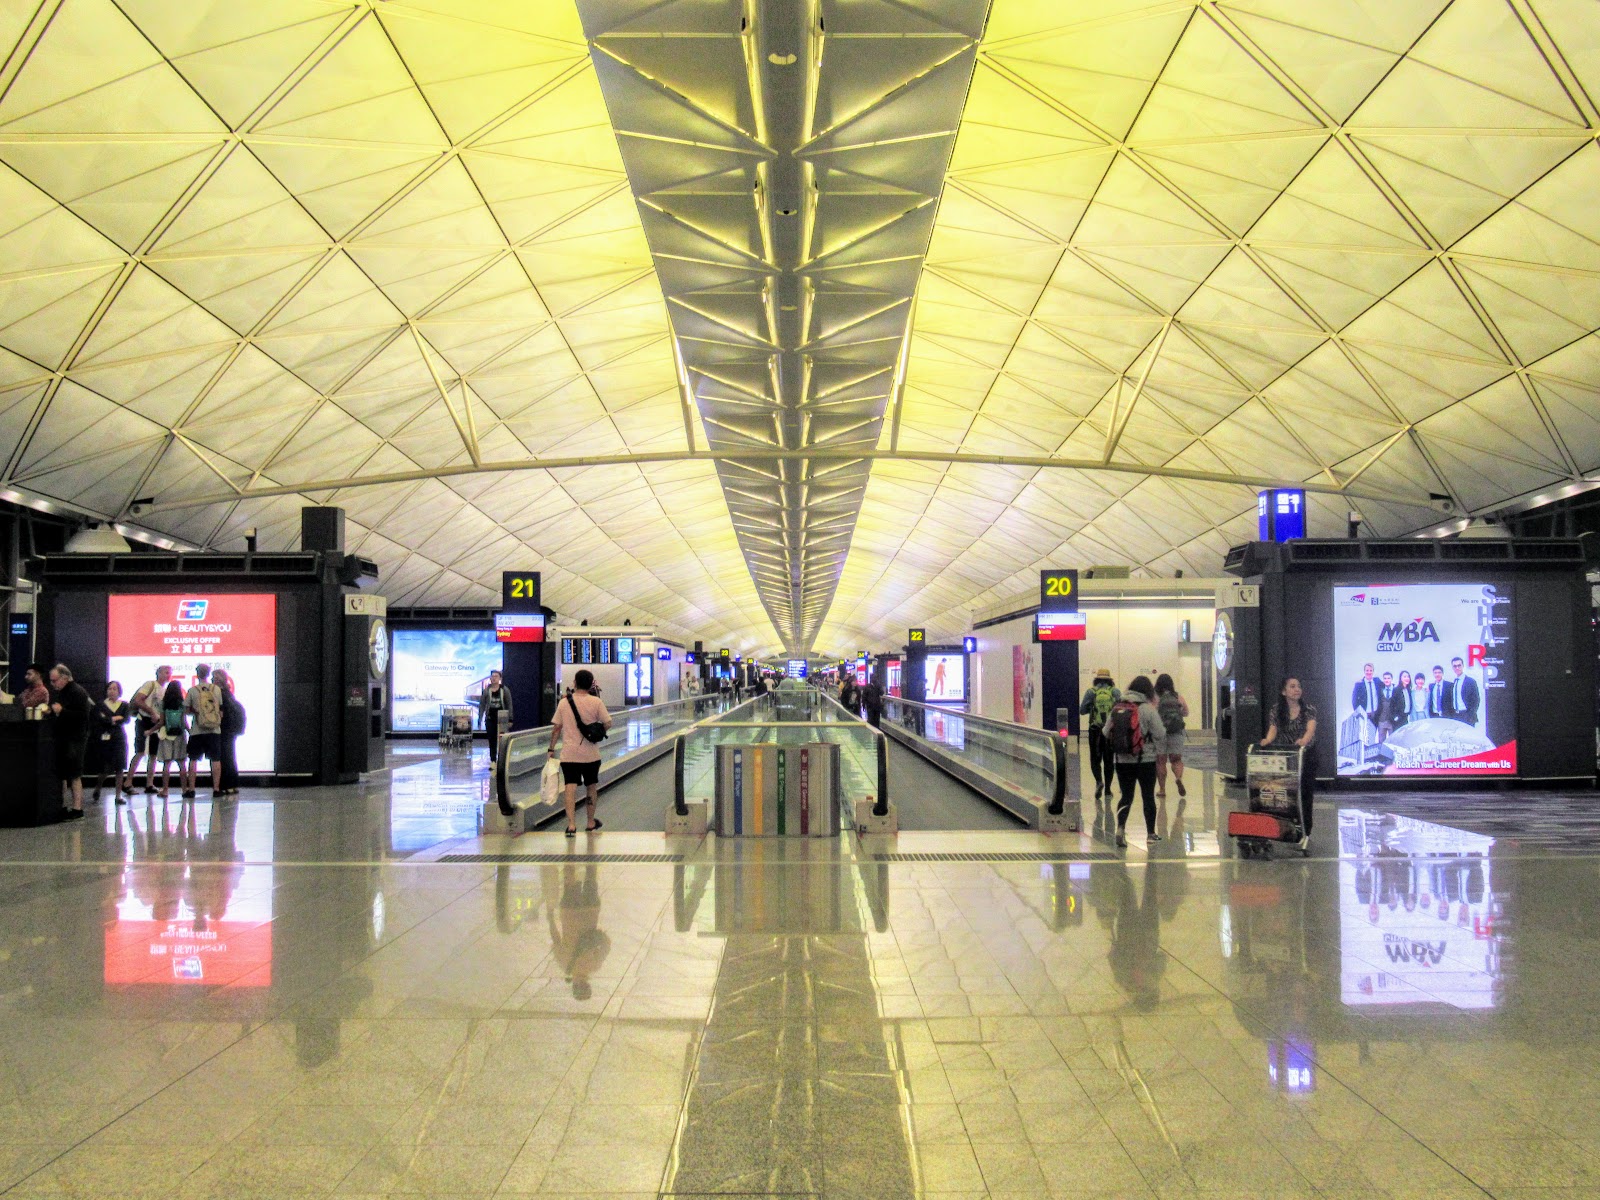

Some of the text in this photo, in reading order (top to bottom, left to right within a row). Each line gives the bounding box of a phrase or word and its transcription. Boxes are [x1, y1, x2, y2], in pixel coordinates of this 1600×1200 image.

[511, 578, 534, 598] 21
[1046, 577, 1072, 596] 20
[178, 624, 232, 632] BEAUTY&YOU
[1378, 618, 1440, 643] MBA
[911, 632, 923, 641] 22
[1377, 643, 1402, 652] CityU
[424, 664, 449, 672] Gateway
[1396, 760, 1420, 769] Reach
[1434, 760, 1460, 769] Career
[1460, 760, 1487, 769] Dream
[1487, 761, 1500, 769] with
[1500, 760, 1512, 769] Us
